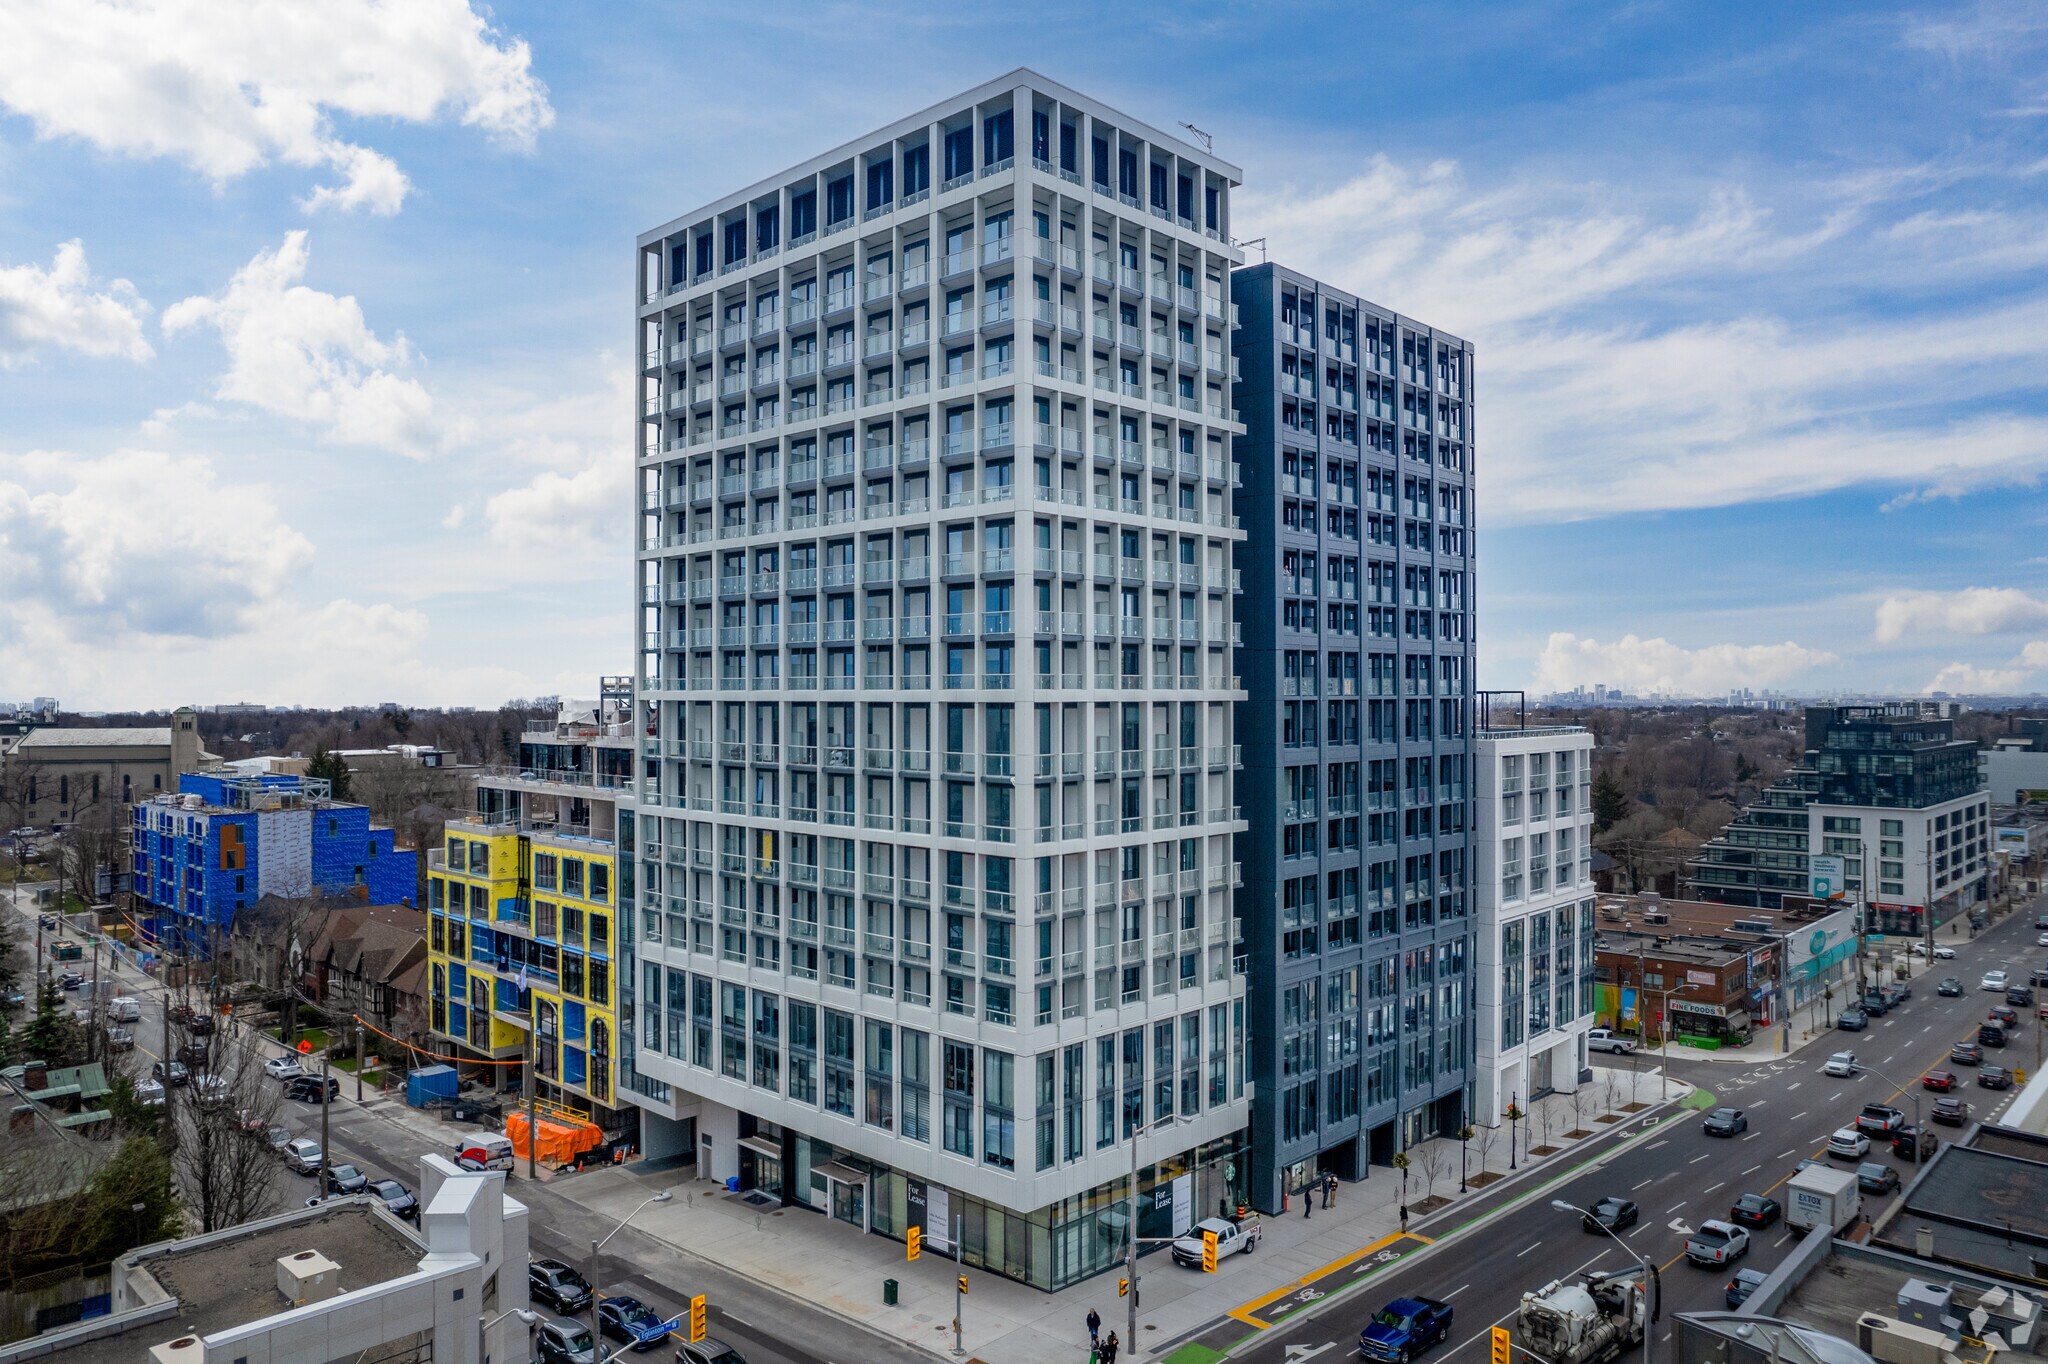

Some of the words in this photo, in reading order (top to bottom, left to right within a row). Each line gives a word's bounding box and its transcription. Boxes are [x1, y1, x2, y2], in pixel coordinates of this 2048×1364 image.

[1671, 1002, 1689, 1010] FINE
[1690, 1005, 1716, 1014] FOODS
[908, 1183, 919, 1195] For
[908, 1192, 926, 1206] Lease
[1155, 1191, 1166, 1200] For
[1798, 1193, 1821, 1205] EXTOX
[1155, 1197, 1171, 1209] Lease
[641, 1326, 665, 1339] Eglinton
